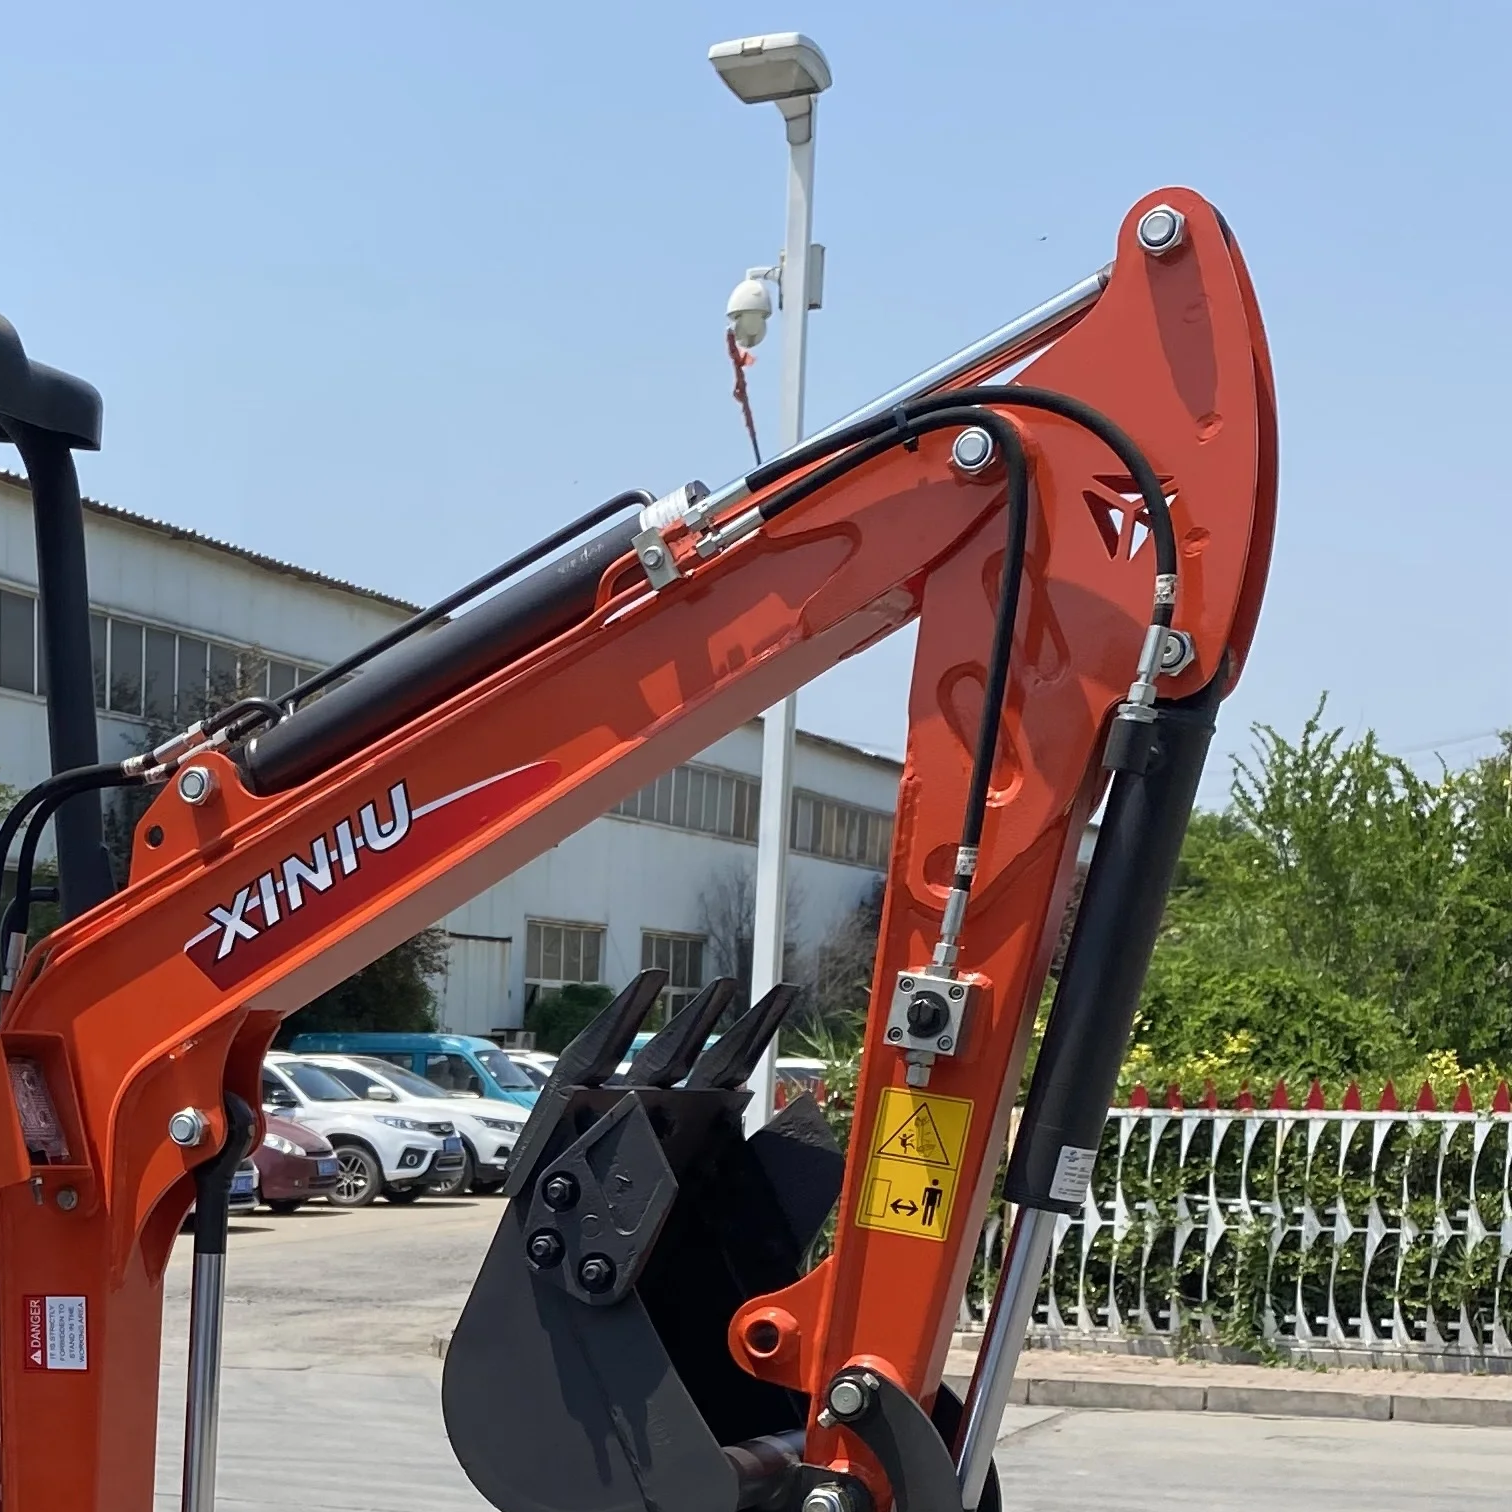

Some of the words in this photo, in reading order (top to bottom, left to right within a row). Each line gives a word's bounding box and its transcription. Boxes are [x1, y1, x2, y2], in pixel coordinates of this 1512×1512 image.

[206, 780, 411, 963] XINIU
[29, 1299, 42, 1348] DANGER
[48, 1304, 56, 1341] STRICTLY
[58, 1303, 65, 1314] TO
